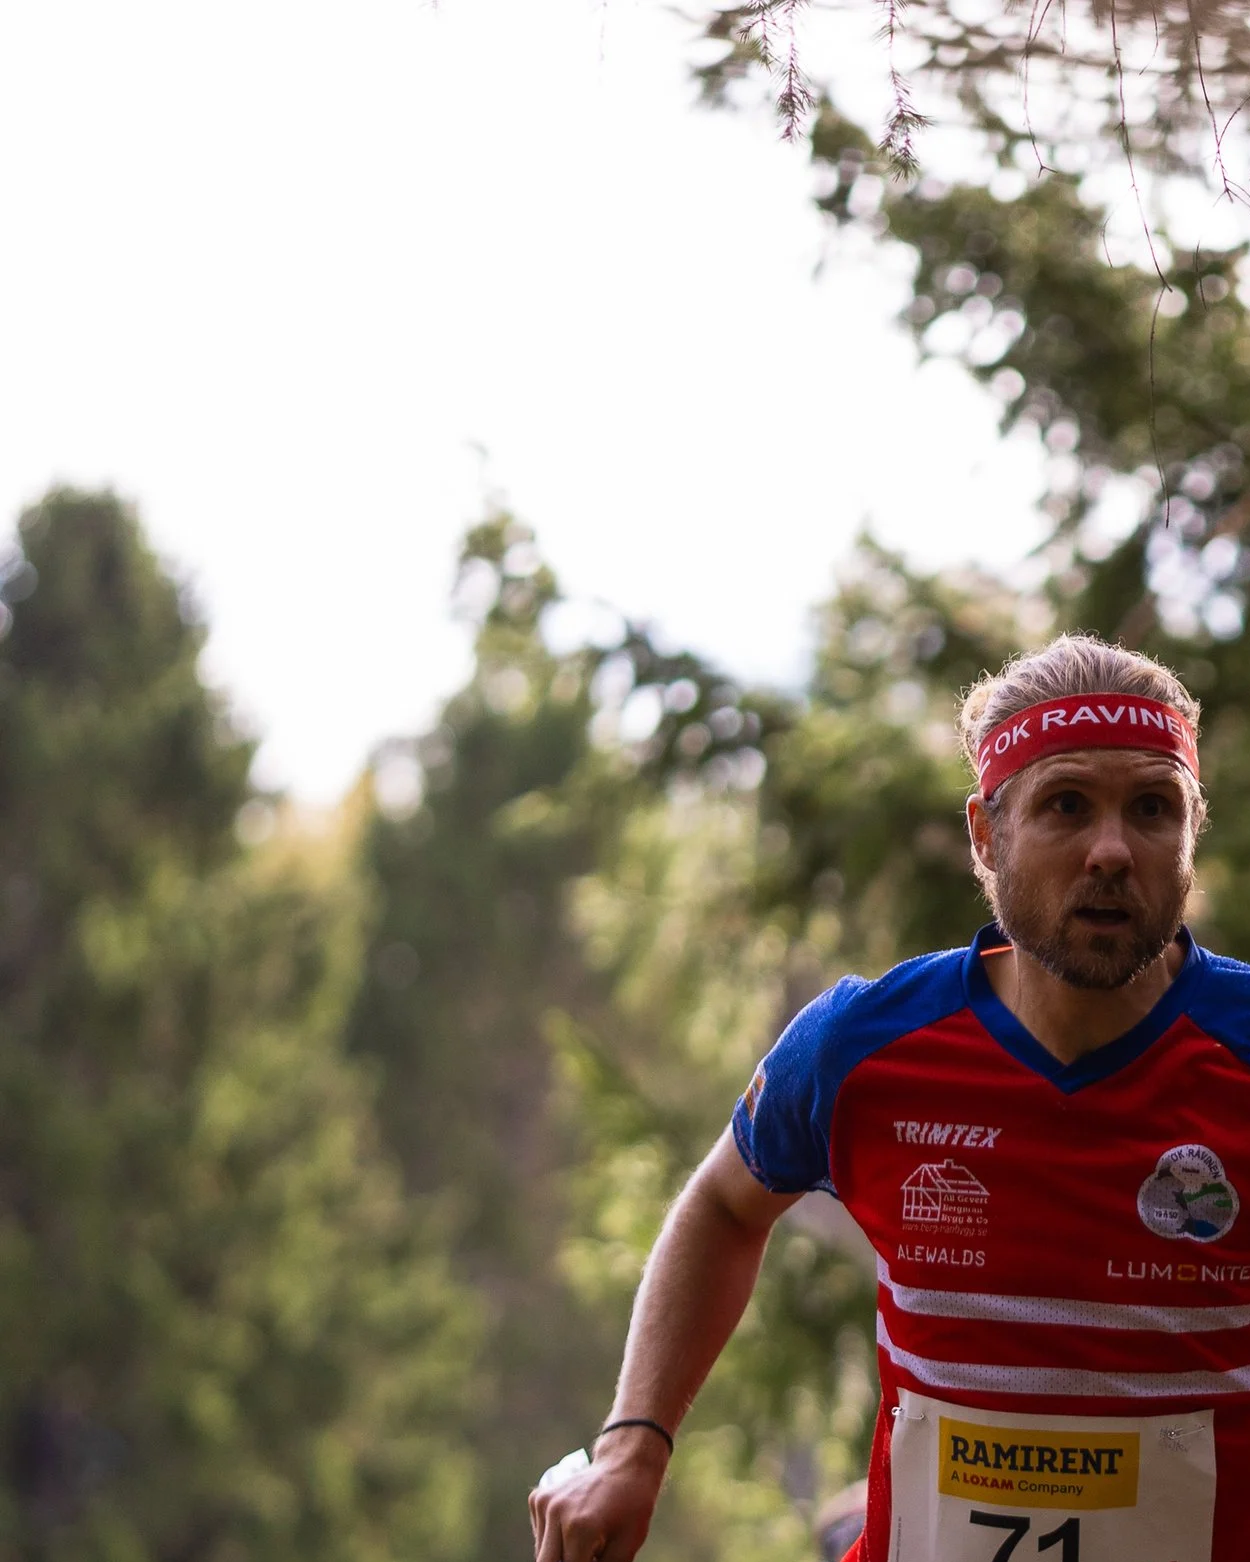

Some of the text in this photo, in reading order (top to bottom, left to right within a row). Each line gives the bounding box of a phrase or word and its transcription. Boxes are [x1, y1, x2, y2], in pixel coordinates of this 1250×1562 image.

[994, 718, 1031, 756] OK
[893, 1120, 1003, 1149] TRIMTEX
[1170, 1150, 1185, 1163] OK
[897, 1243, 986, 1267] ALEWALDS
[950, 1435, 1123, 1476] RAMIRENT
[950, 1470, 1084, 1497] A LOXAM Company
